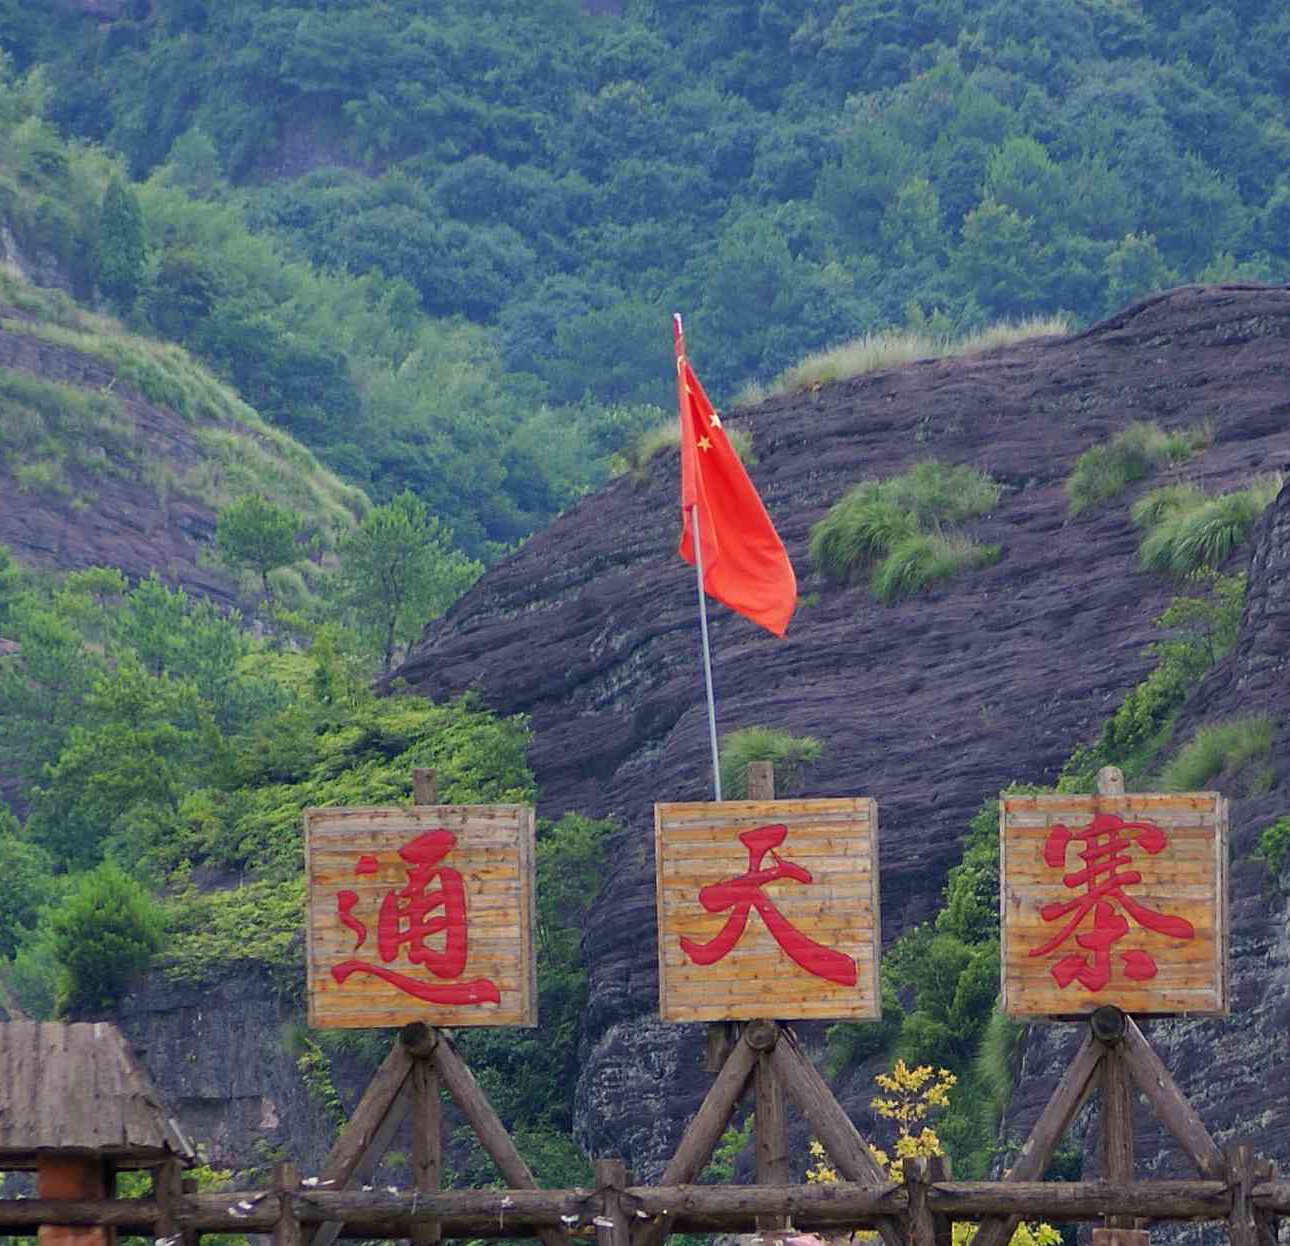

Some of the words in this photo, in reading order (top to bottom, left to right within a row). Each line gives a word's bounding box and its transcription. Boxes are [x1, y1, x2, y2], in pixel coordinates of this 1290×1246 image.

[330, 828, 501, 1006] 通
[679, 823, 858, 988] 天
[1029, 812, 1197, 993] 寨
